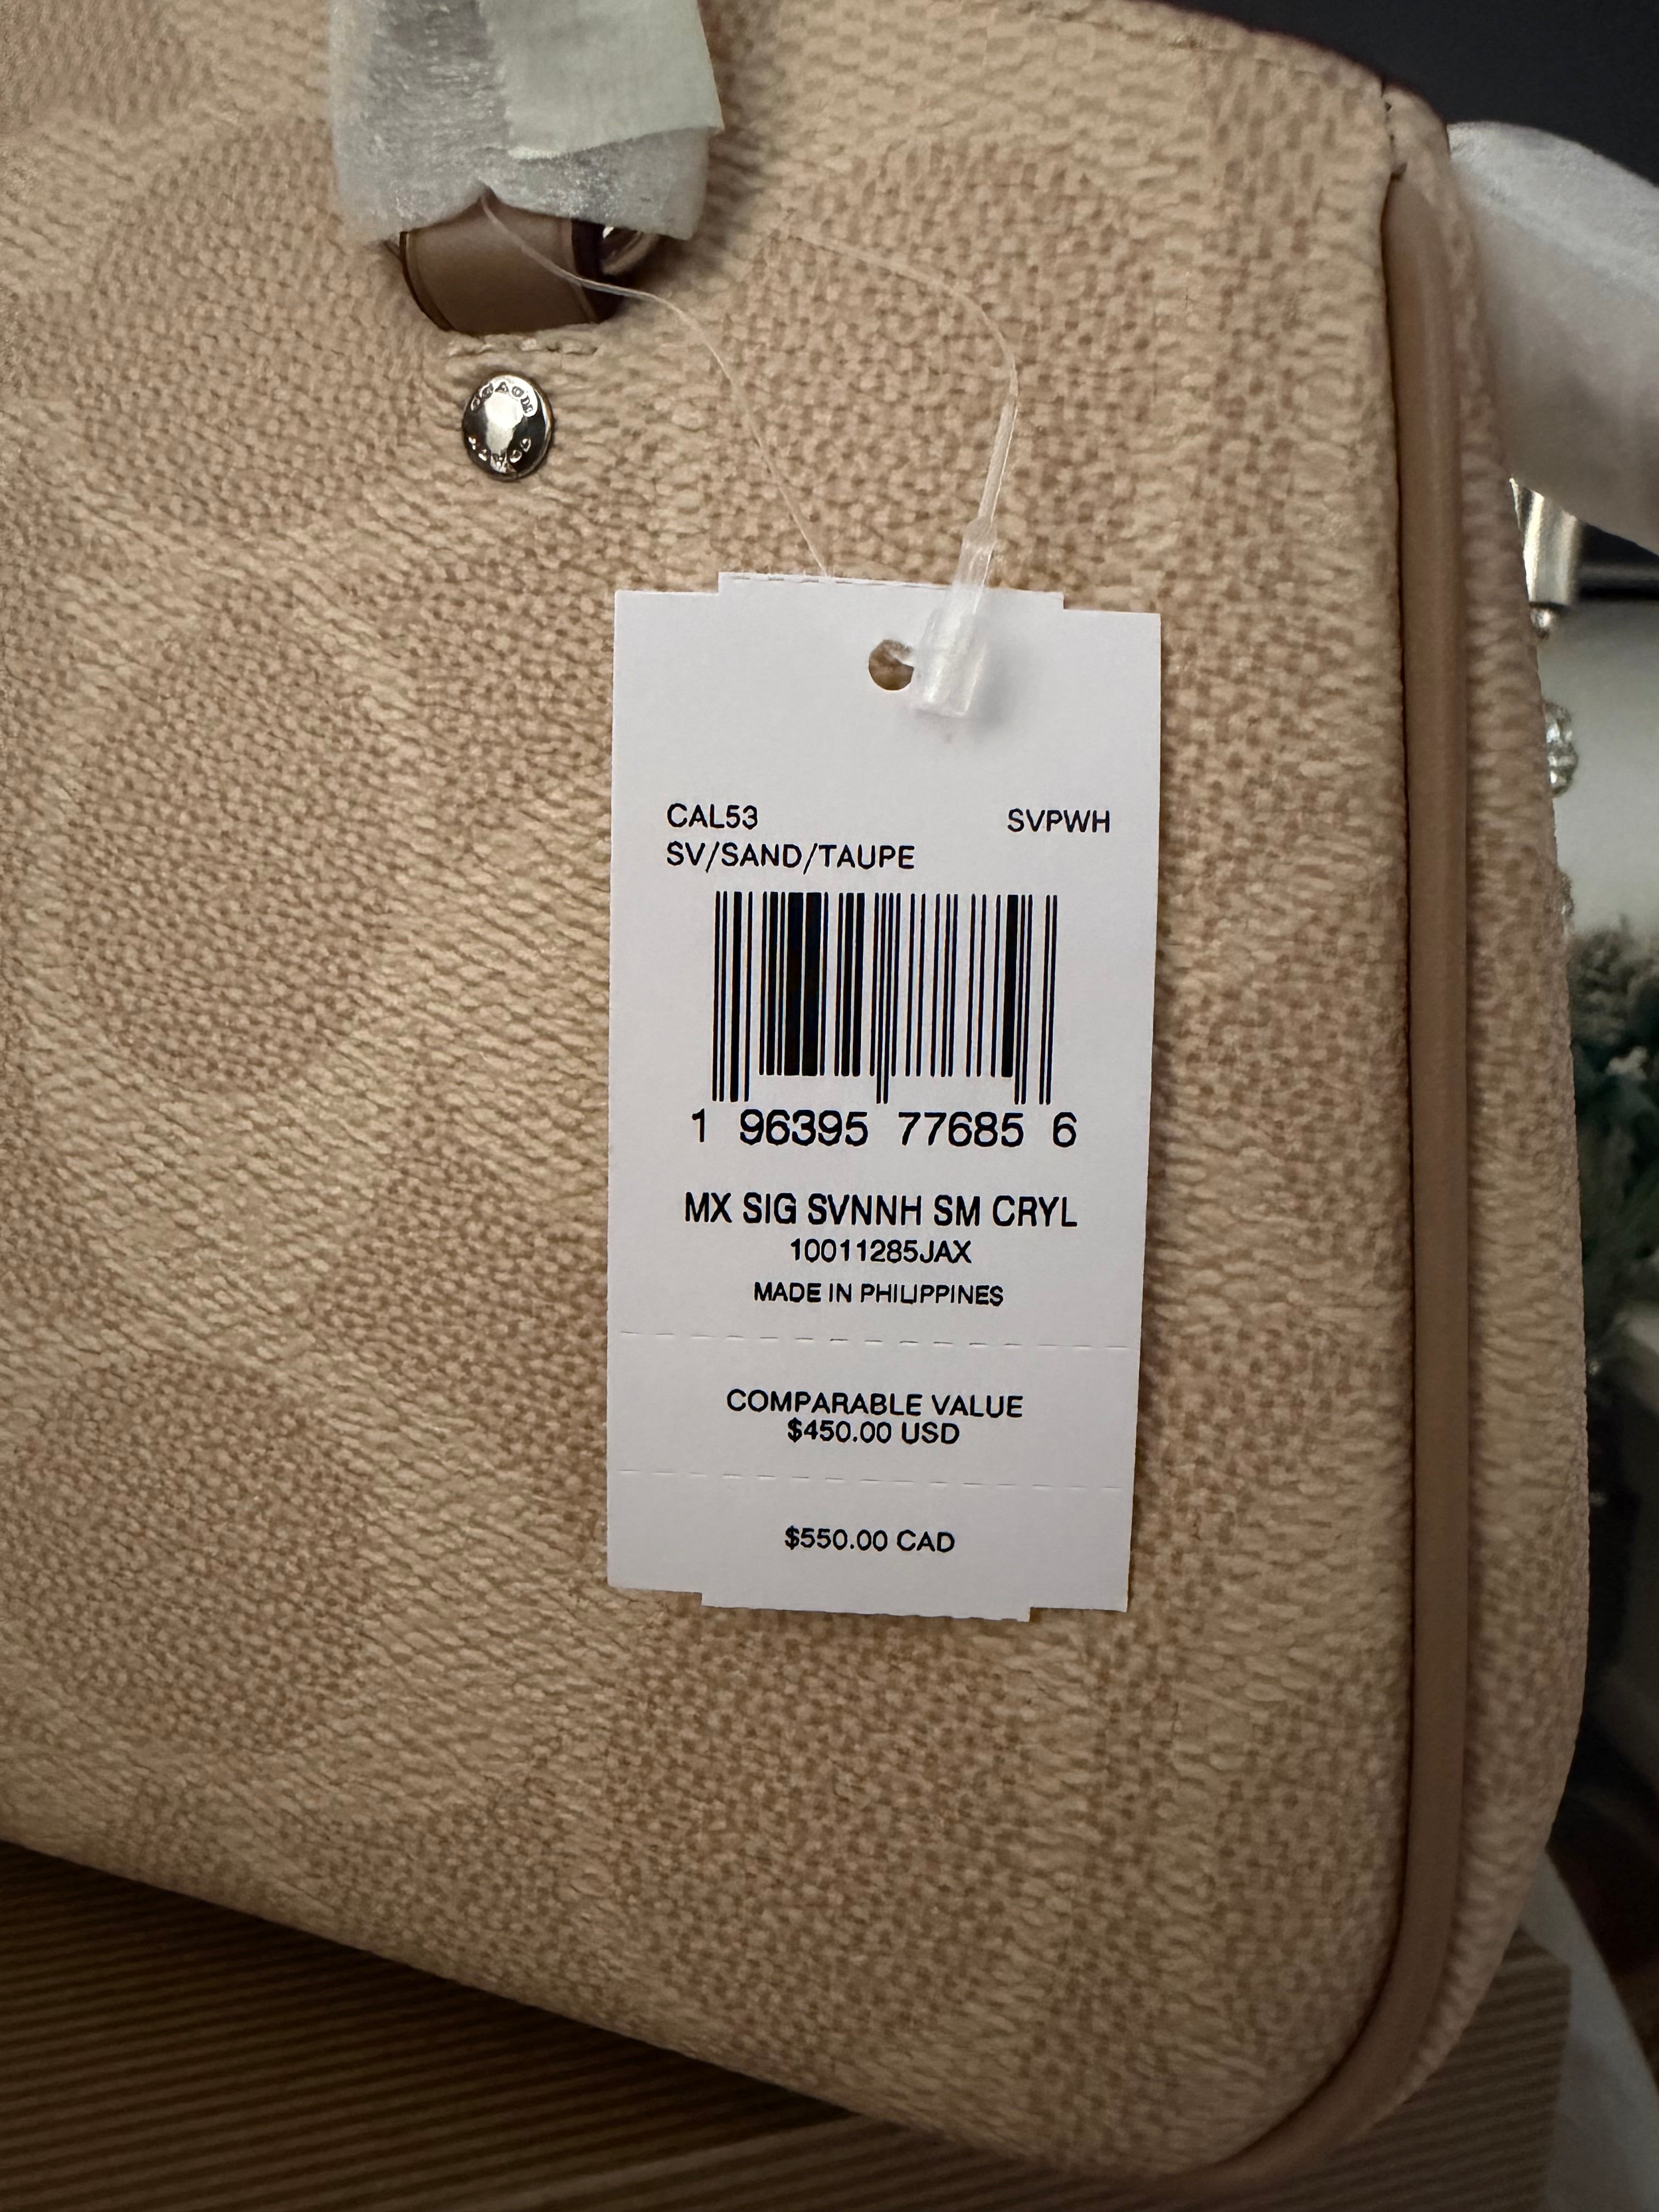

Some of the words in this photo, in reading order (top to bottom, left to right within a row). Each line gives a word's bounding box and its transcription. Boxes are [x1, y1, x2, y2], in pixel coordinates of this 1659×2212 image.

[667, 803, 758, 830] CAL53
[1007, 808, 1110, 833] SVPWH
[667, 840, 915, 875] SV/SAND/TAUPE
[691, 1108, 705, 1143] 1
[740, 1109, 868, 1147] 96395
[898, 1111, 1024, 1148] 77685
[1053, 1111, 1077, 1148] 6
[685, 1192, 732, 1223] MX
[743, 1192, 797, 1224] SIG
[808, 1193, 922, 1226] SVNNH
[934, 1194, 980, 1227] SM
[992, 1195, 1077, 1227] CRYL
[790, 1238, 972, 1264] 10011285JAX
[754, 1282, 822, 1303] MADE
[828, 1283, 852, 1303] IN
[860, 1283, 1004, 1307] PHILIPPINES
[726, 1389, 923, 1417] COMPARABLE
[931, 1394, 1023, 1419] VALUE
[787, 1418, 892, 1444] $450.00
[901, 1421, 960, 1445] USD
[784, 1525, 888, 1552] $550.00
[896, 1529, 955, 1553] CAD
